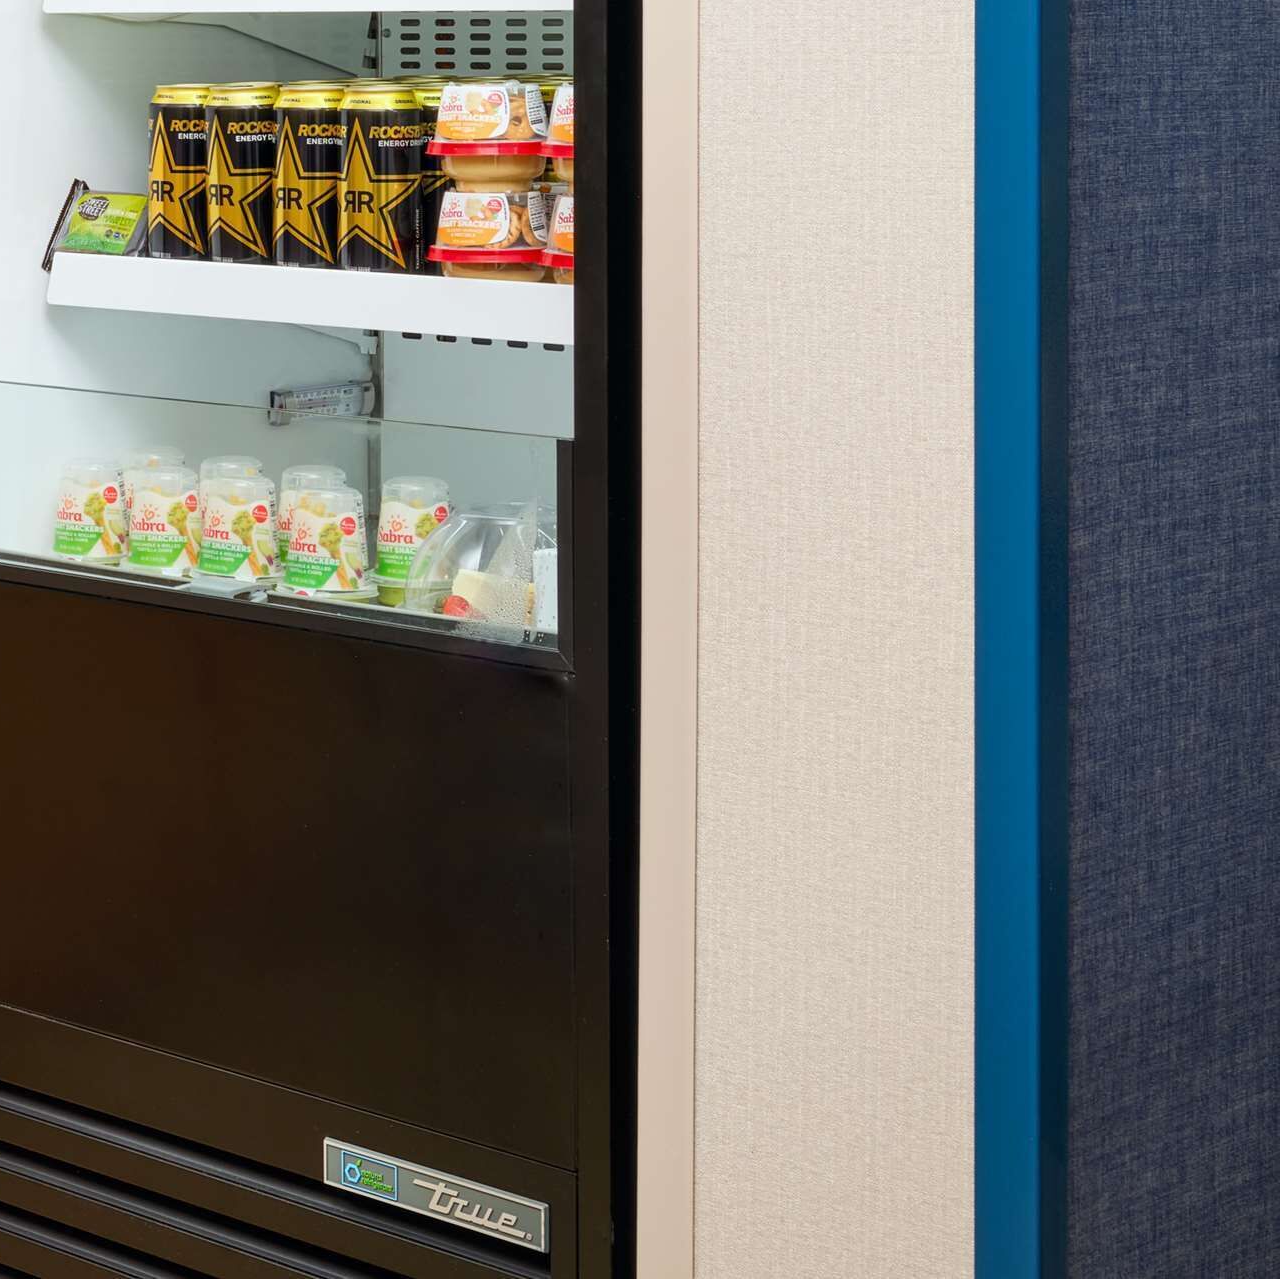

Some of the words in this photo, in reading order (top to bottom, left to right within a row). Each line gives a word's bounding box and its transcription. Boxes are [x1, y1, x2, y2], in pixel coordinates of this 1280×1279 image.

[235, 134, 267, 142] ENERGY
[131, 519, 167, 532] Sabra
[203, 526, 229, 540] abra
[379, 530, 414, 544] Sabra
[290, 538, 317, 554] abra
[298, 555, 340, 566] SNACKERS
[413, 1182, 533, 1240] true
